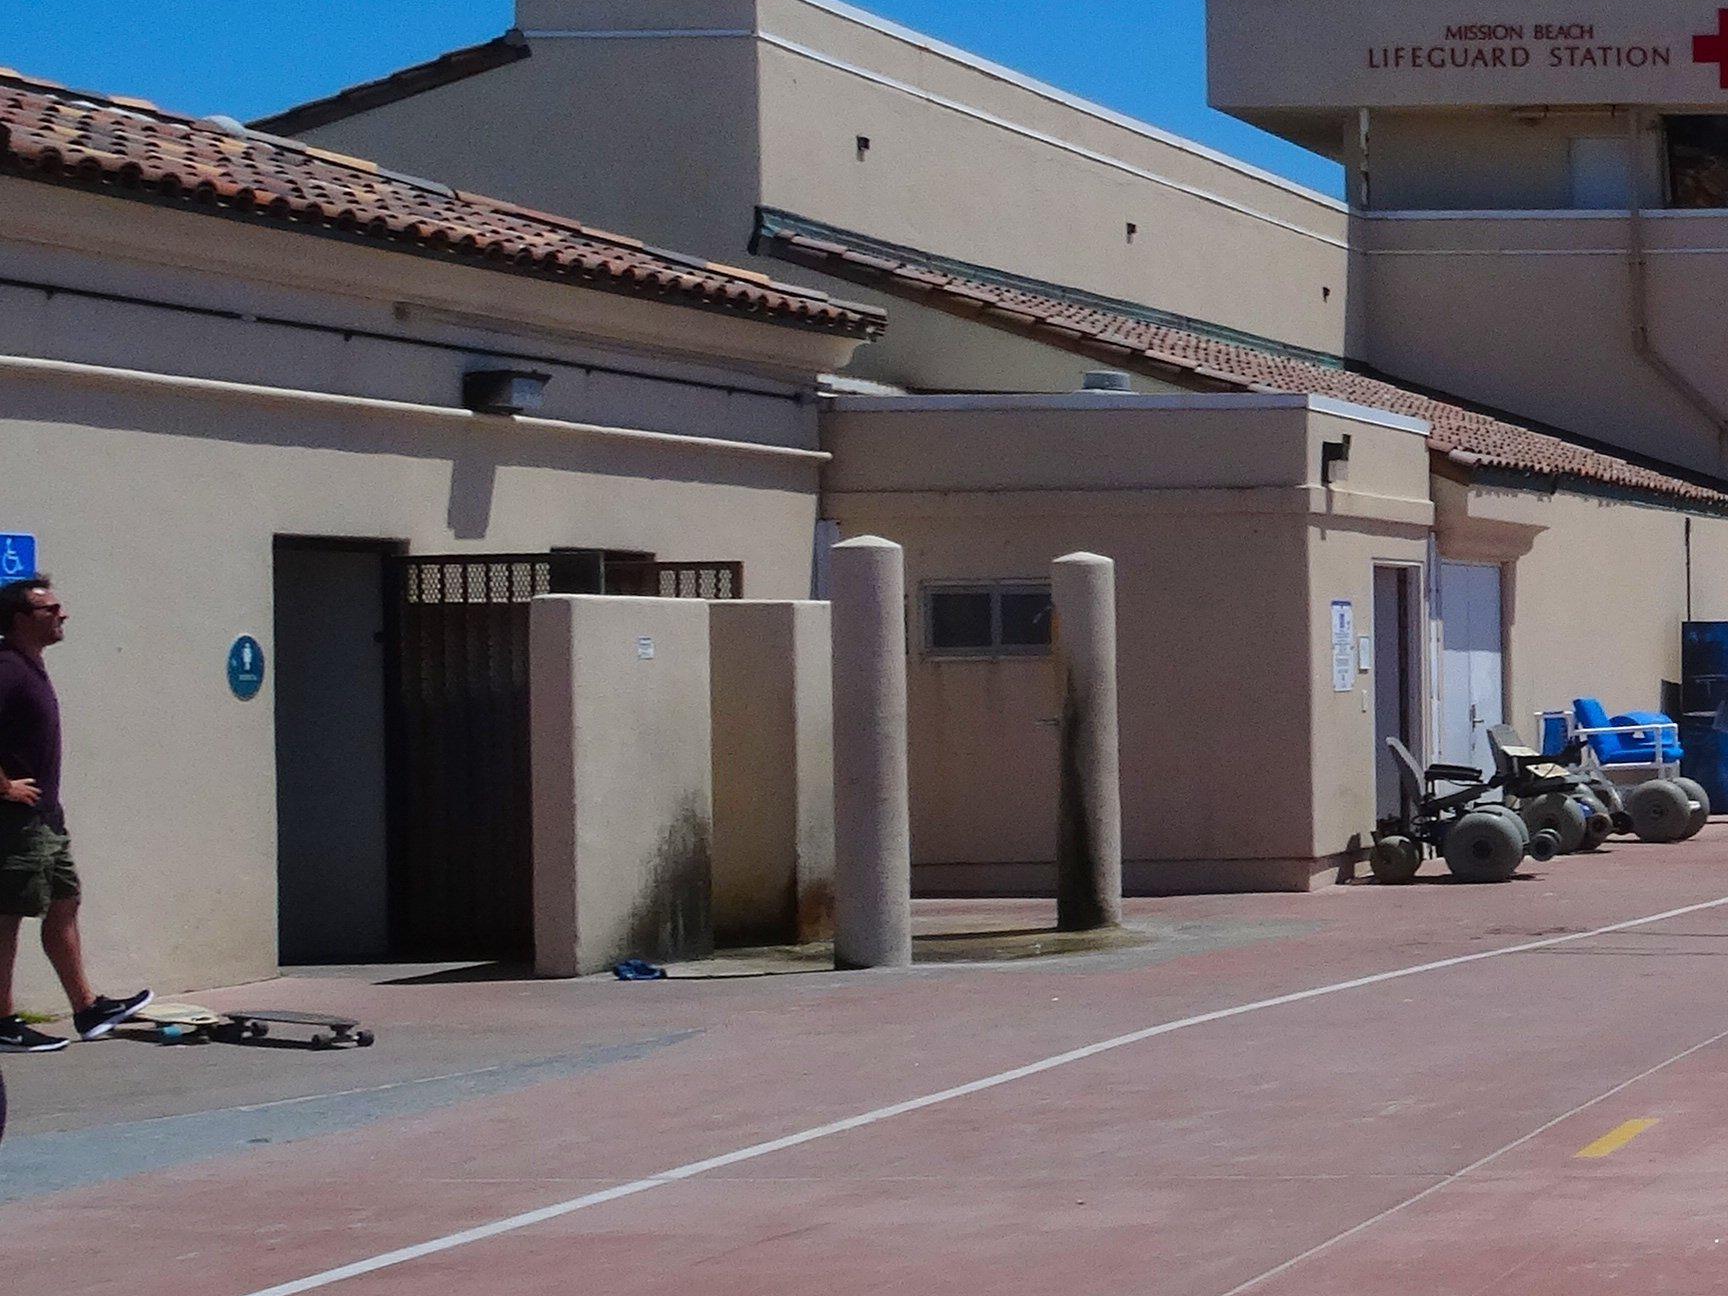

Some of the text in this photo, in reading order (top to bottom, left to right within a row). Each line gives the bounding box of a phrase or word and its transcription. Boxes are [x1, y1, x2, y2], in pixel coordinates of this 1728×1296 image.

[1444, 23, 1594, 41] MISSION BEACH
[1367, 45, 1672, 69] LIFEGUARD STATION
